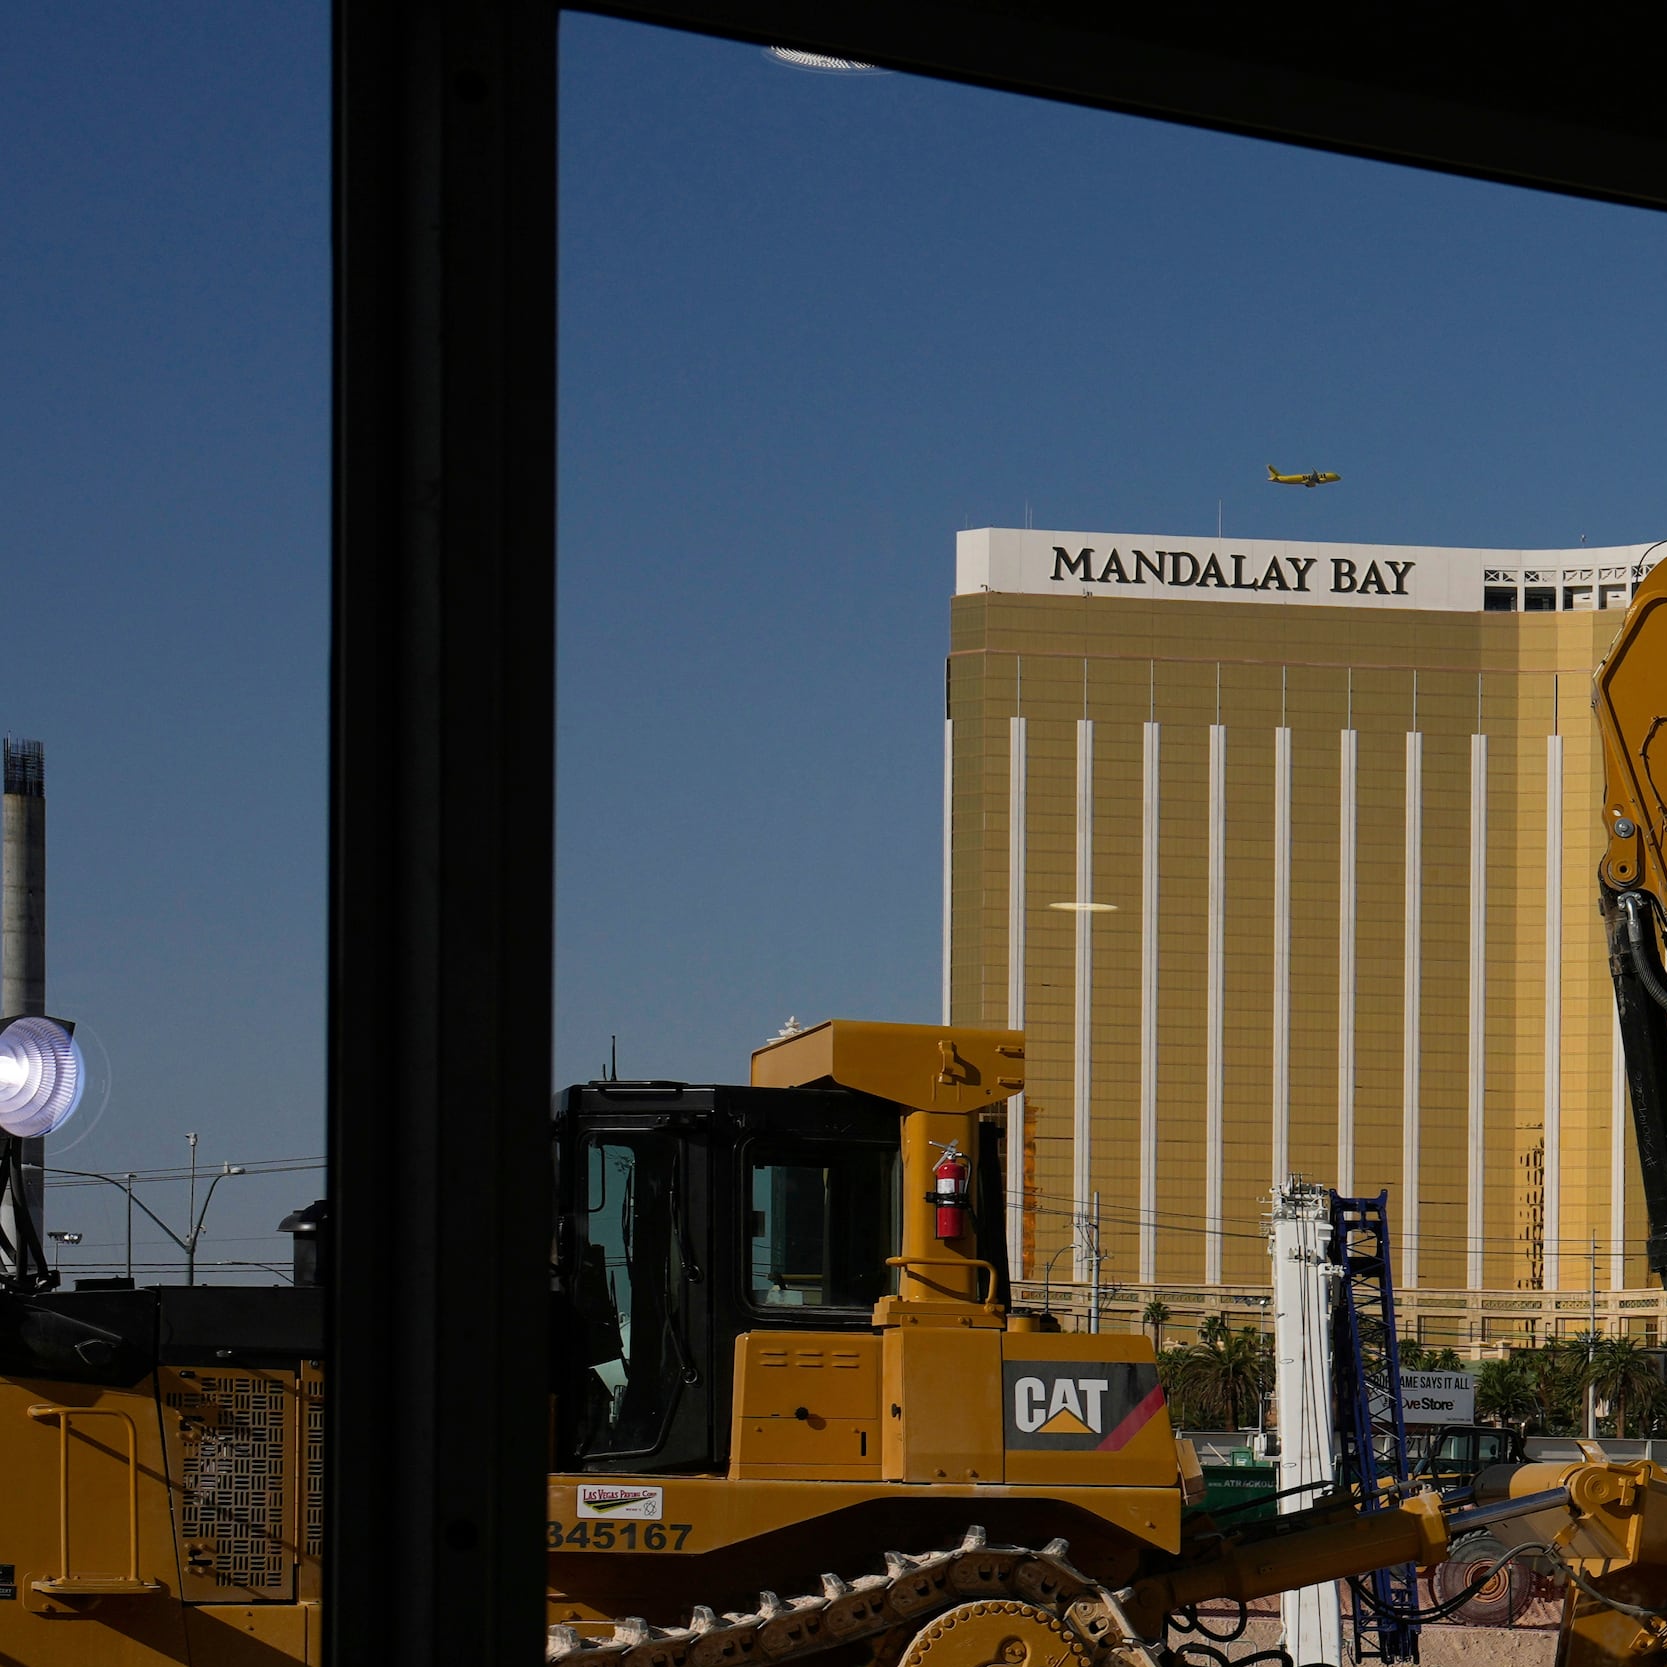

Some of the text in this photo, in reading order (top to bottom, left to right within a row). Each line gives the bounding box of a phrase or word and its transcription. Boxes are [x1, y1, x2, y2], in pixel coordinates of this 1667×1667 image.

[1050, 547, 1415, 595] MANDALAY BAY
[1399, 1376, 1419, 1389] AME
[1420, 1376, 1442, 1389] SAYS
[1444, 1377, 1452, 1389] IT
[1454, 1378, 1470, 1390] ALL
[1015, 1376, 1108, 1434] CAT
[1421, 1397, 1454, 1411] Store
